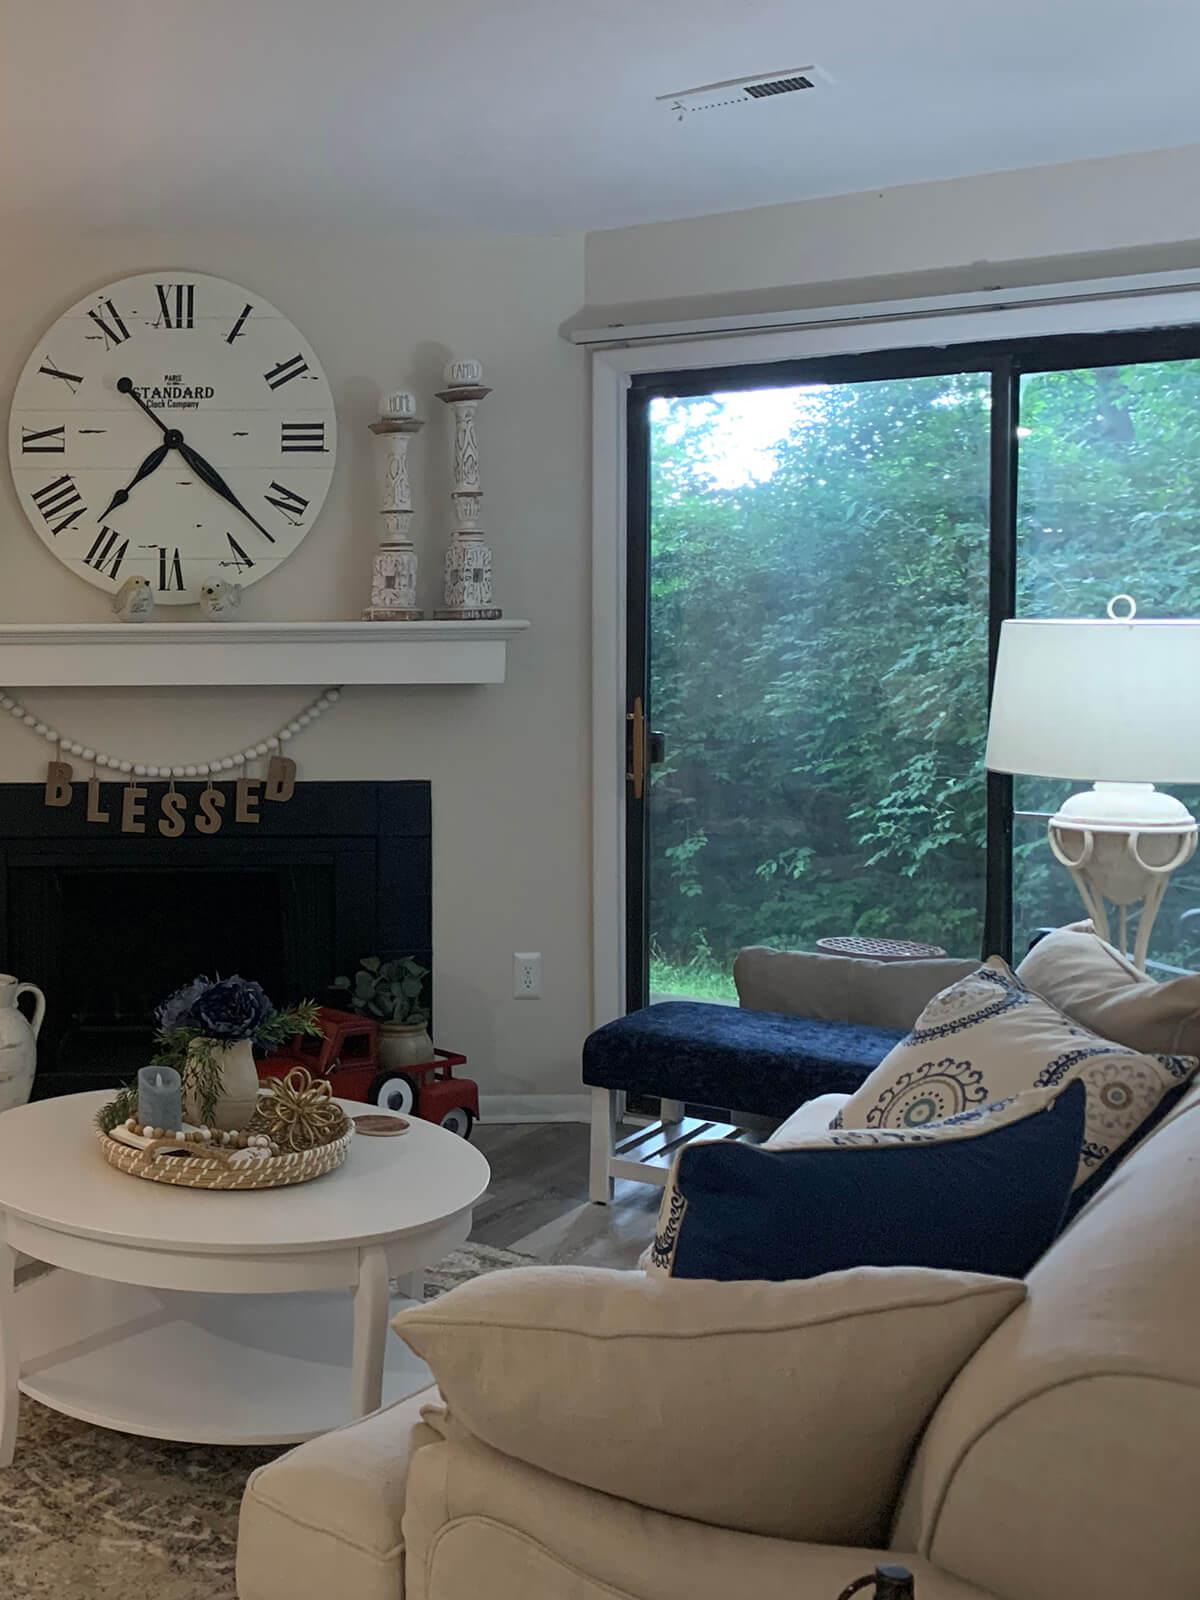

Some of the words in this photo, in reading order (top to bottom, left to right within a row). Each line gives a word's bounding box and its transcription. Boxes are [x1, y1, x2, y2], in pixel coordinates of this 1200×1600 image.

[88, 300, 131, 351] XI
[154, 284, 195, 329] XII
[226, 303, 253, 344] I
[38, 355, 84, 395] X
[264, 353, 310, 390] II
[133, 386, 214, 400] STANDARD
[146, 400, 165, 409] Clock
[167, 399, 199, 410] Company
[389, 394, 410, 412] HOME
[22, 424, 65, 454] IX
[281, 422, 325, 454] III
[31, 474, 88, 537] VIII
[264, 481, 310, 526] IV
[82, 525, 130, 581] VII
[157, 548, 186, 591] VI
[226, 532, 255, 574] V
[45, 756, 297, 837] BLESSED
